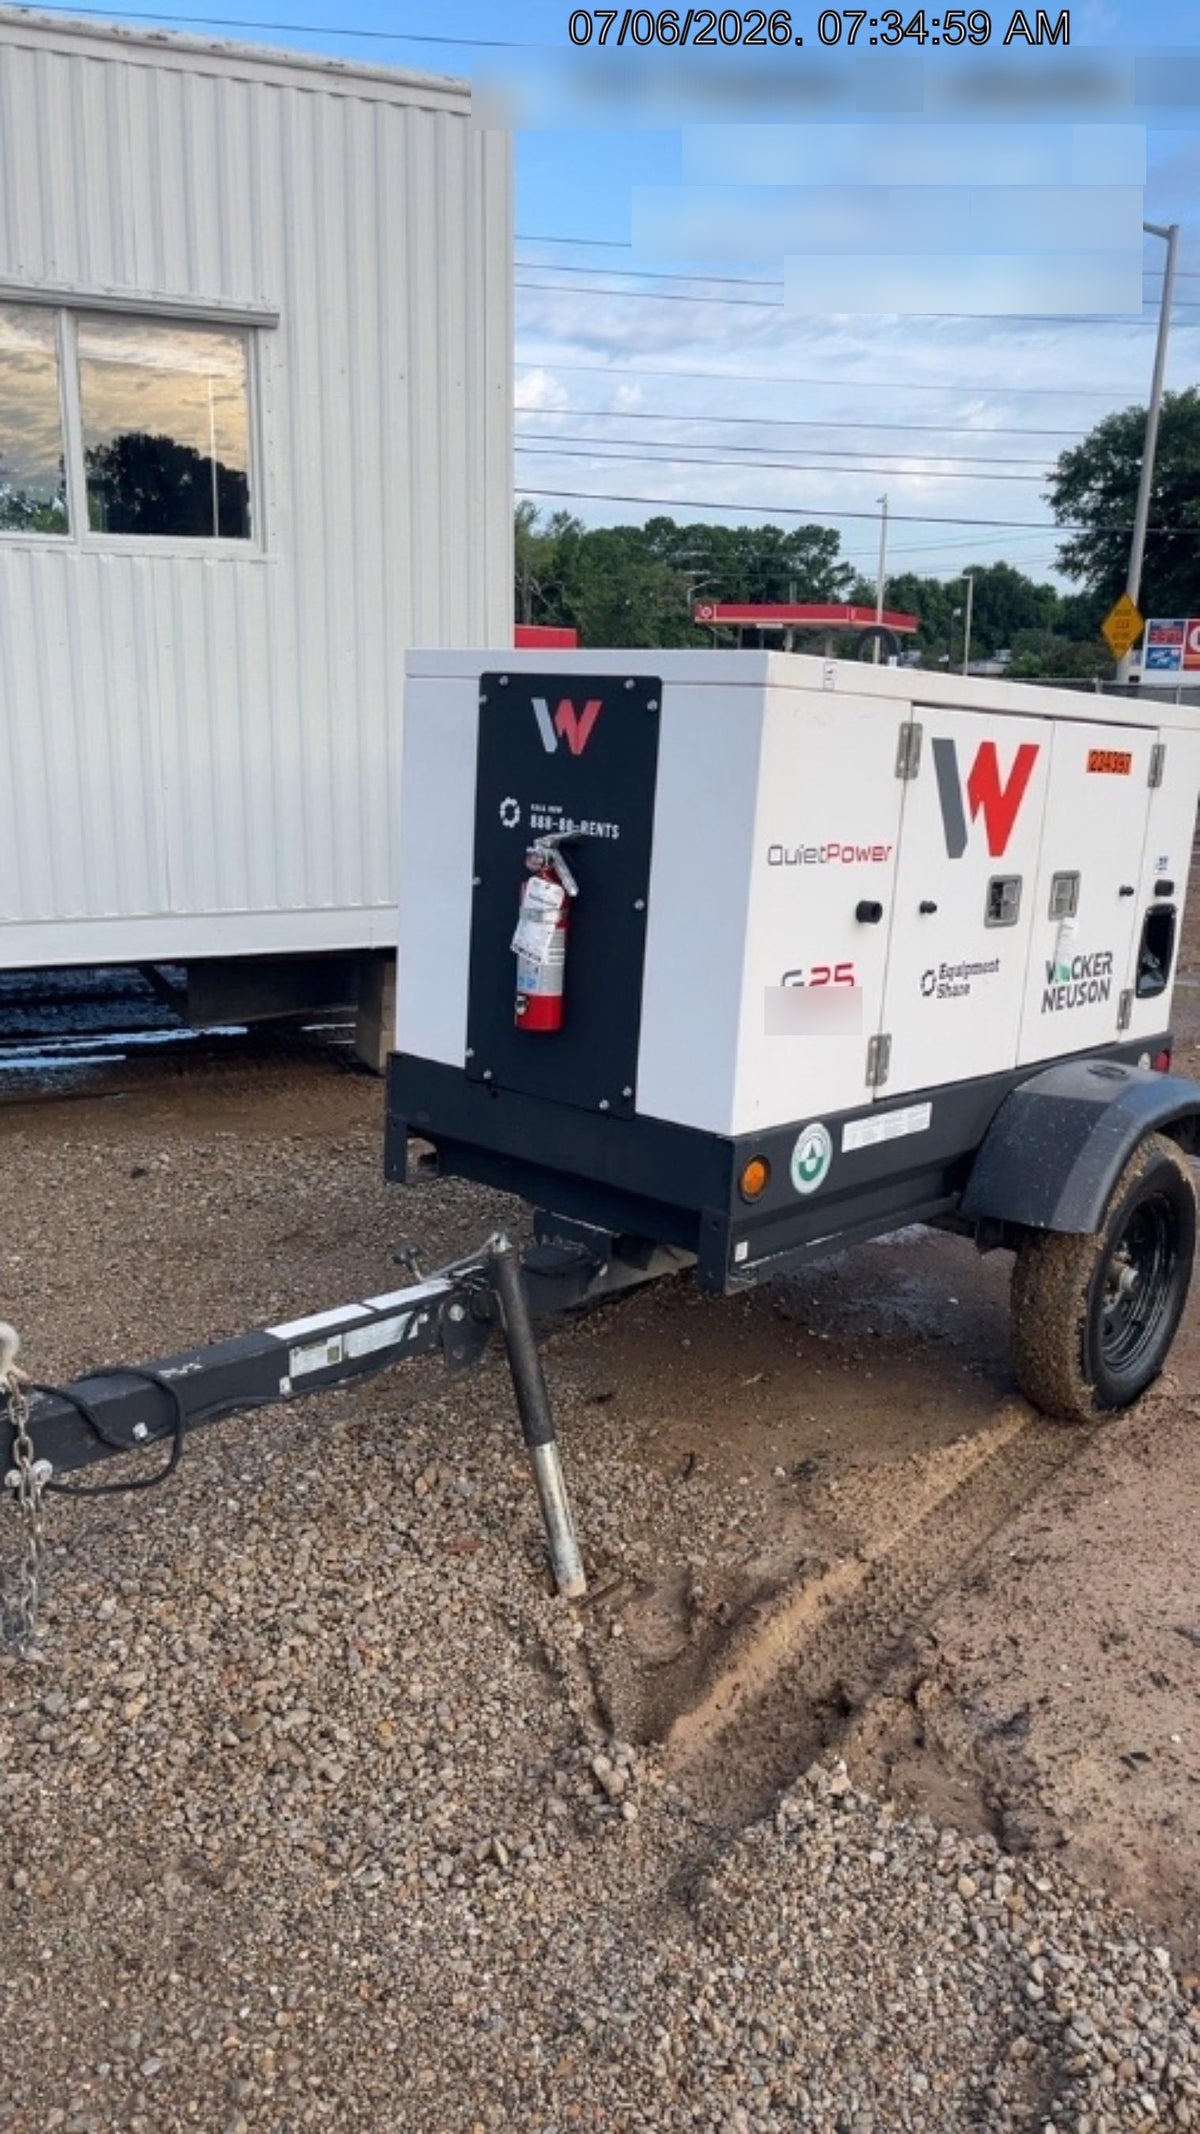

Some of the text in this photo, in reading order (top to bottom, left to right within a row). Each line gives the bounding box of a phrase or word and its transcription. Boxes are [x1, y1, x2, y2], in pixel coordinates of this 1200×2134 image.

[768, 843, 893, 866] QuietPower
[938, 957, 1000, 981] Equipment
[1045, 951, 1113, 985] WCKER
[936, 982, 970, 999] Share
[1040, 976, 1111, 1015] NEUSON
